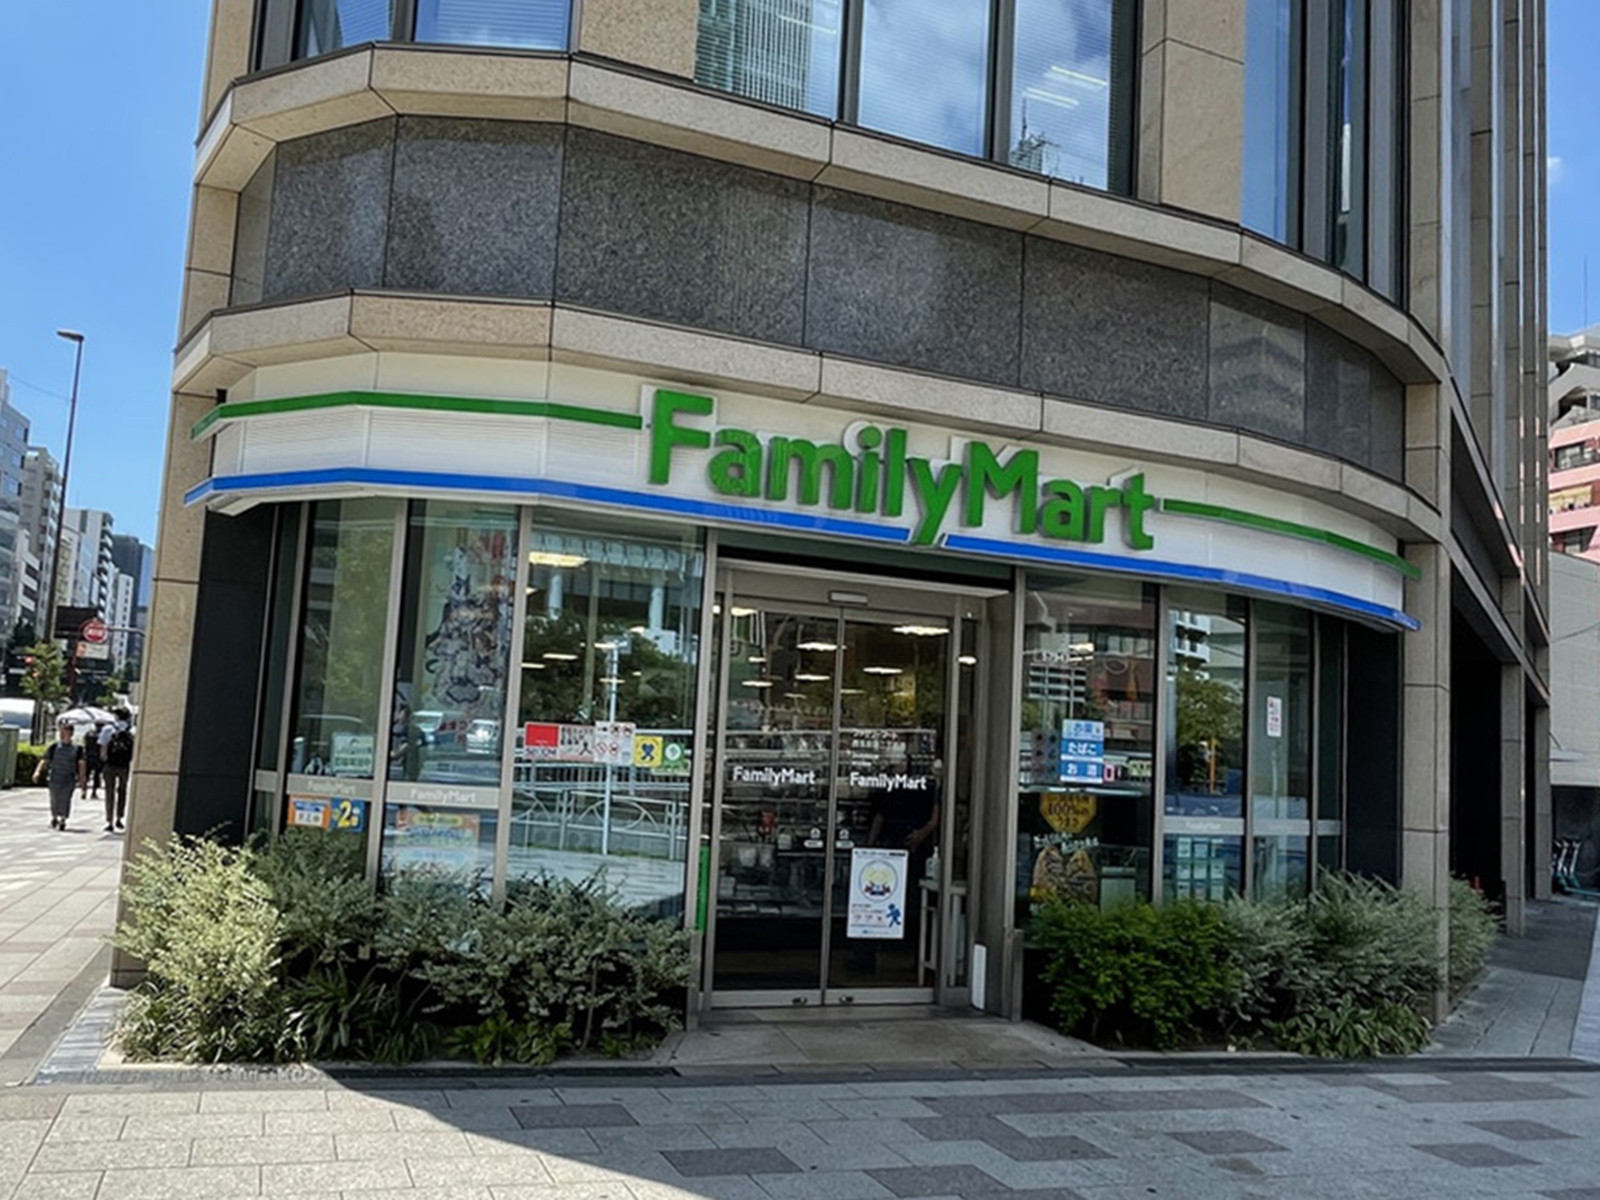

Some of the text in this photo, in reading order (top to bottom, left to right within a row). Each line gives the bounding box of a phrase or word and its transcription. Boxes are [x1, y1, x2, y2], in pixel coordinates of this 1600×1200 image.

[648, 388, 1155, 551] FamilyMart
[1067, 741, 1098, 756] たばこ
[732, 765, 817, 786] FamilyMart
[849, 771, 927, 793] FamilyMart
[410, 787, 476, 805] FamilyMart
